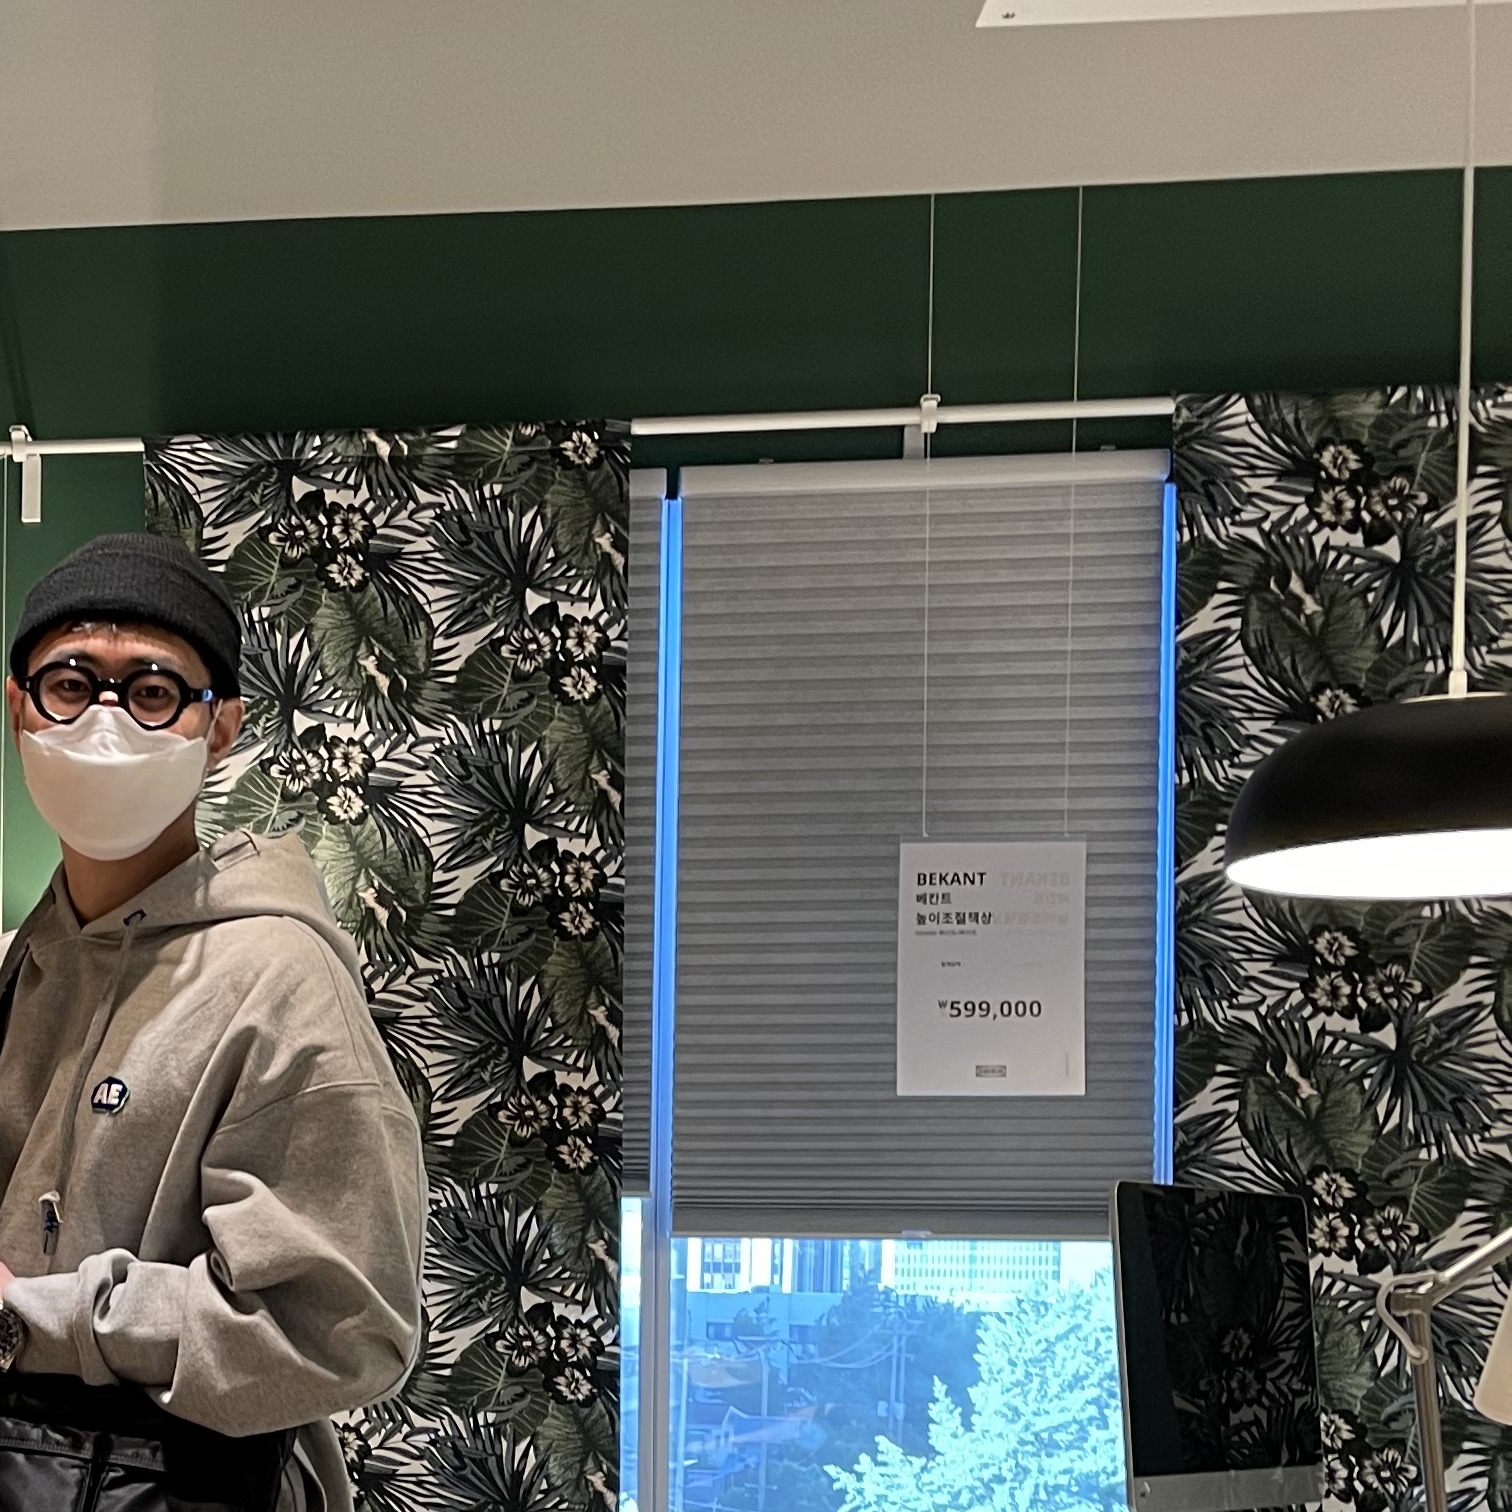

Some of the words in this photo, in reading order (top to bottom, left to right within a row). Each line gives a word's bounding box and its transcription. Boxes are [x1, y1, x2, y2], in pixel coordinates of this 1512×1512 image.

[916, 872, 988, 887] BEKANT
[915, 892, 952, 906] 베칸트
[915, 911, 992, 926] 높이조절책상
[937, 1000, 1043, 1021] ₩599,000
